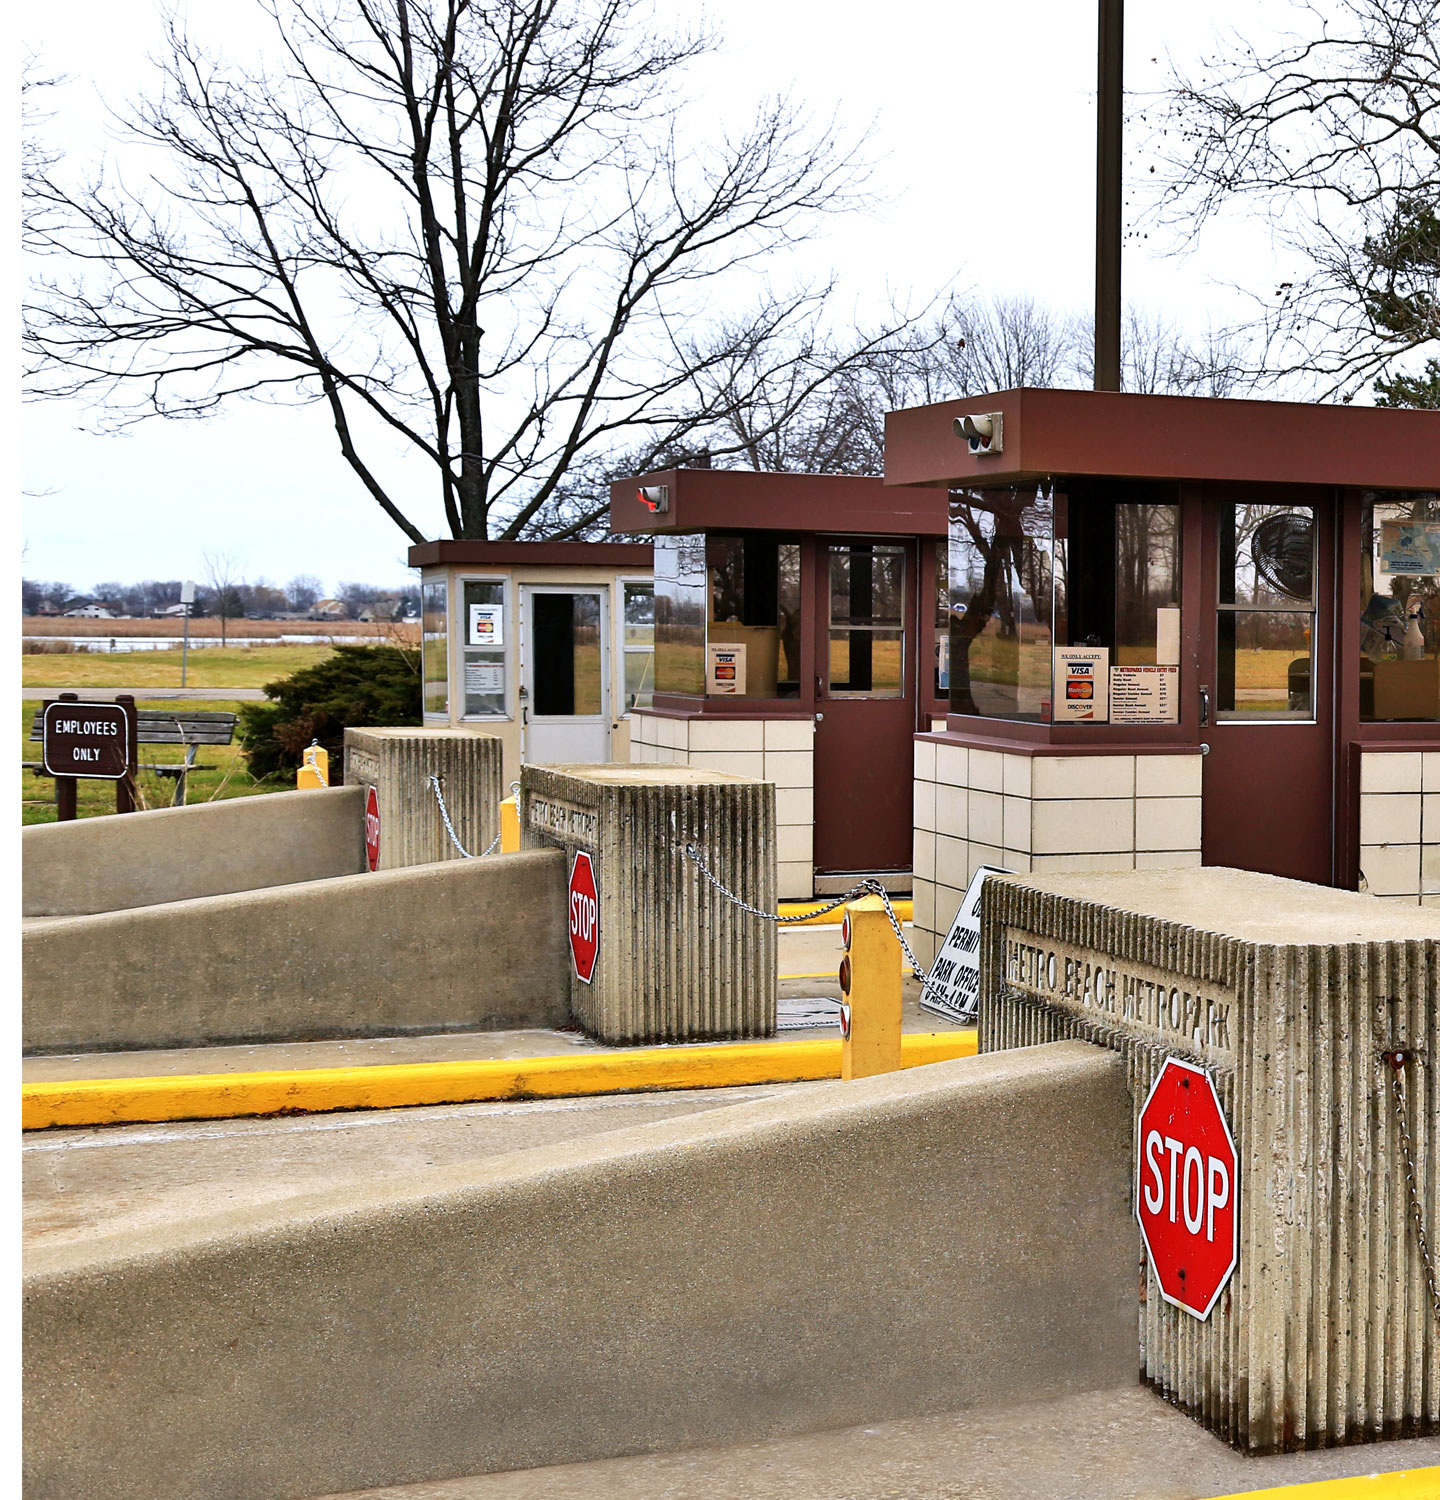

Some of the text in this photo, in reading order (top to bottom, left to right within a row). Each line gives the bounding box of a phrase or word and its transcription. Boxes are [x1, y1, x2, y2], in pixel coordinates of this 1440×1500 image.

[1071, 667, 1090, 675] VISA
[55, 719, 117, 736] EMPLOYEES
[73, 747, 100, 761] ONLY
[571, 890, 596, 943] STOP
[949, 925, 980, 954] PERMIT
[931, 957, 957, 984] PARK
[1007, 939, 1231, 1051] METRO BEACH METROPARK
[1144, 1129, 1230, 1243] STOP
